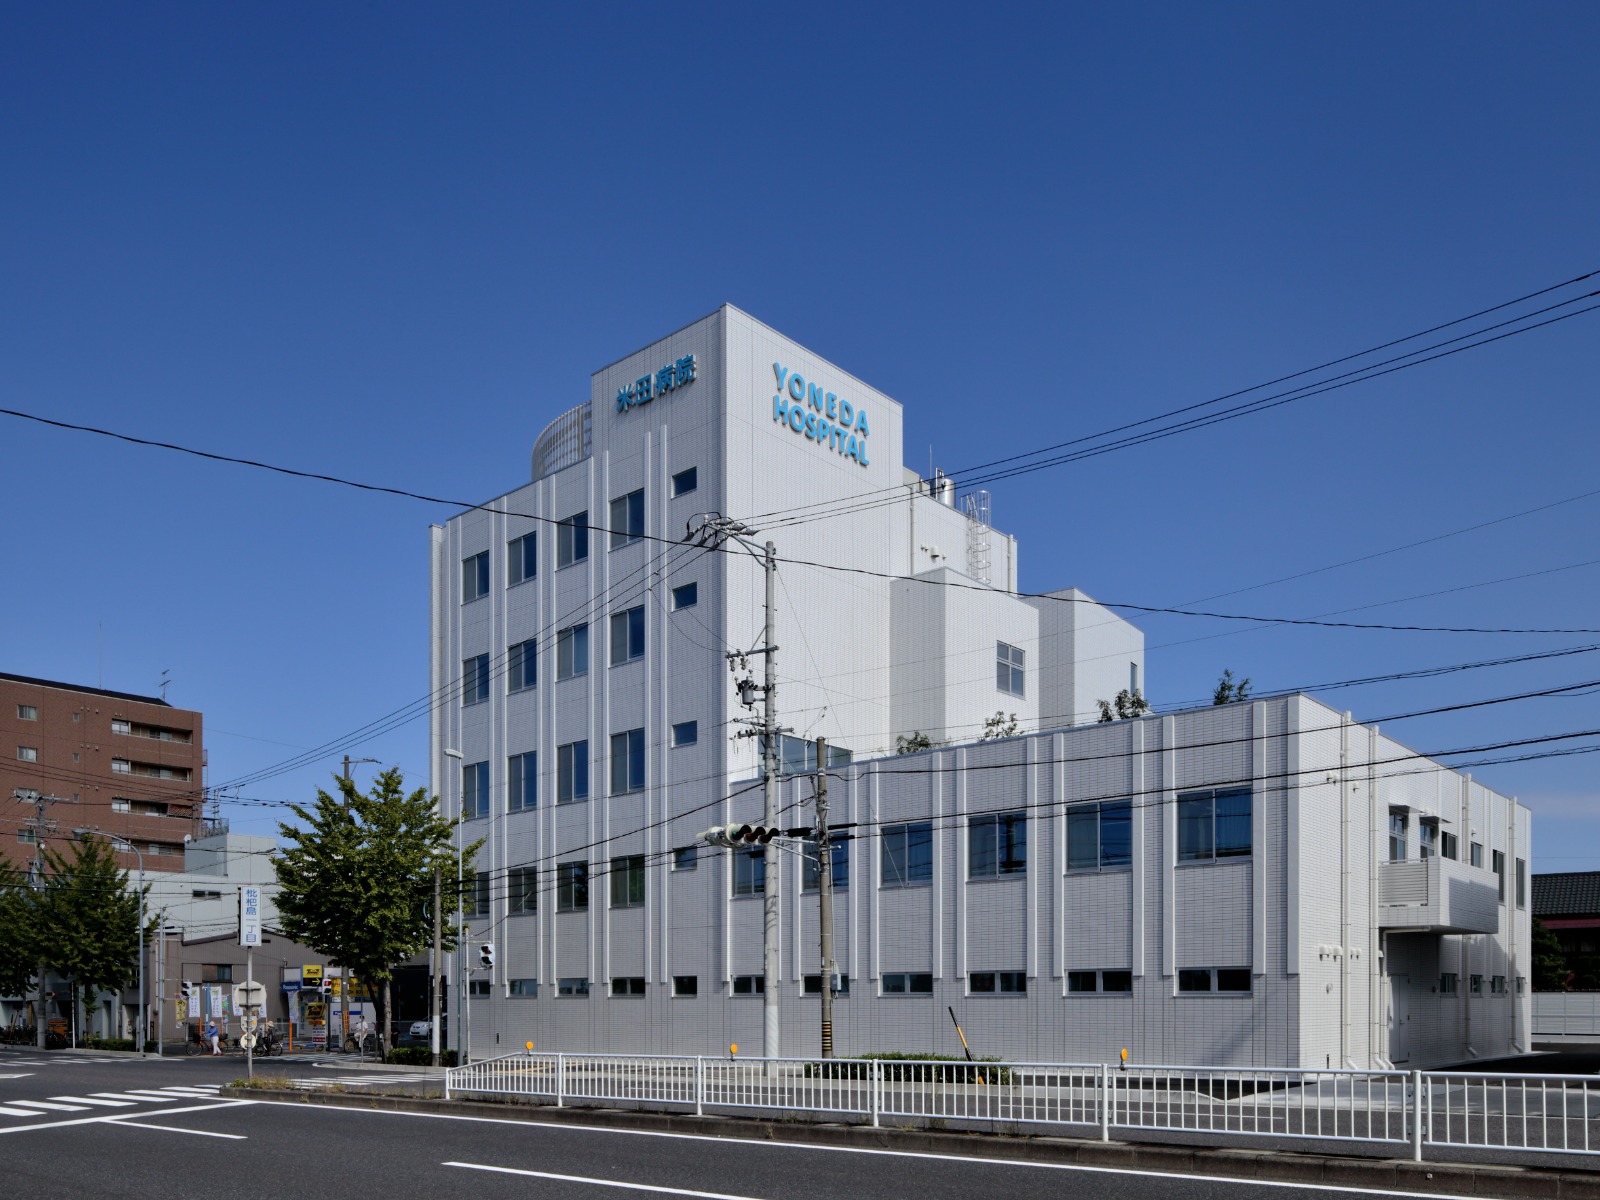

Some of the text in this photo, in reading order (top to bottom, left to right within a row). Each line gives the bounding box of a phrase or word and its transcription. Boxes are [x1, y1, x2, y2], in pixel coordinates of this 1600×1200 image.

[616, 354, 697, 412] 米田病院
[773, 362, 870, 436] YONEDA
[773, 395, 870, 466] HOSPITAL
[246, 889, 257, 942] 枇杷島一丁目
